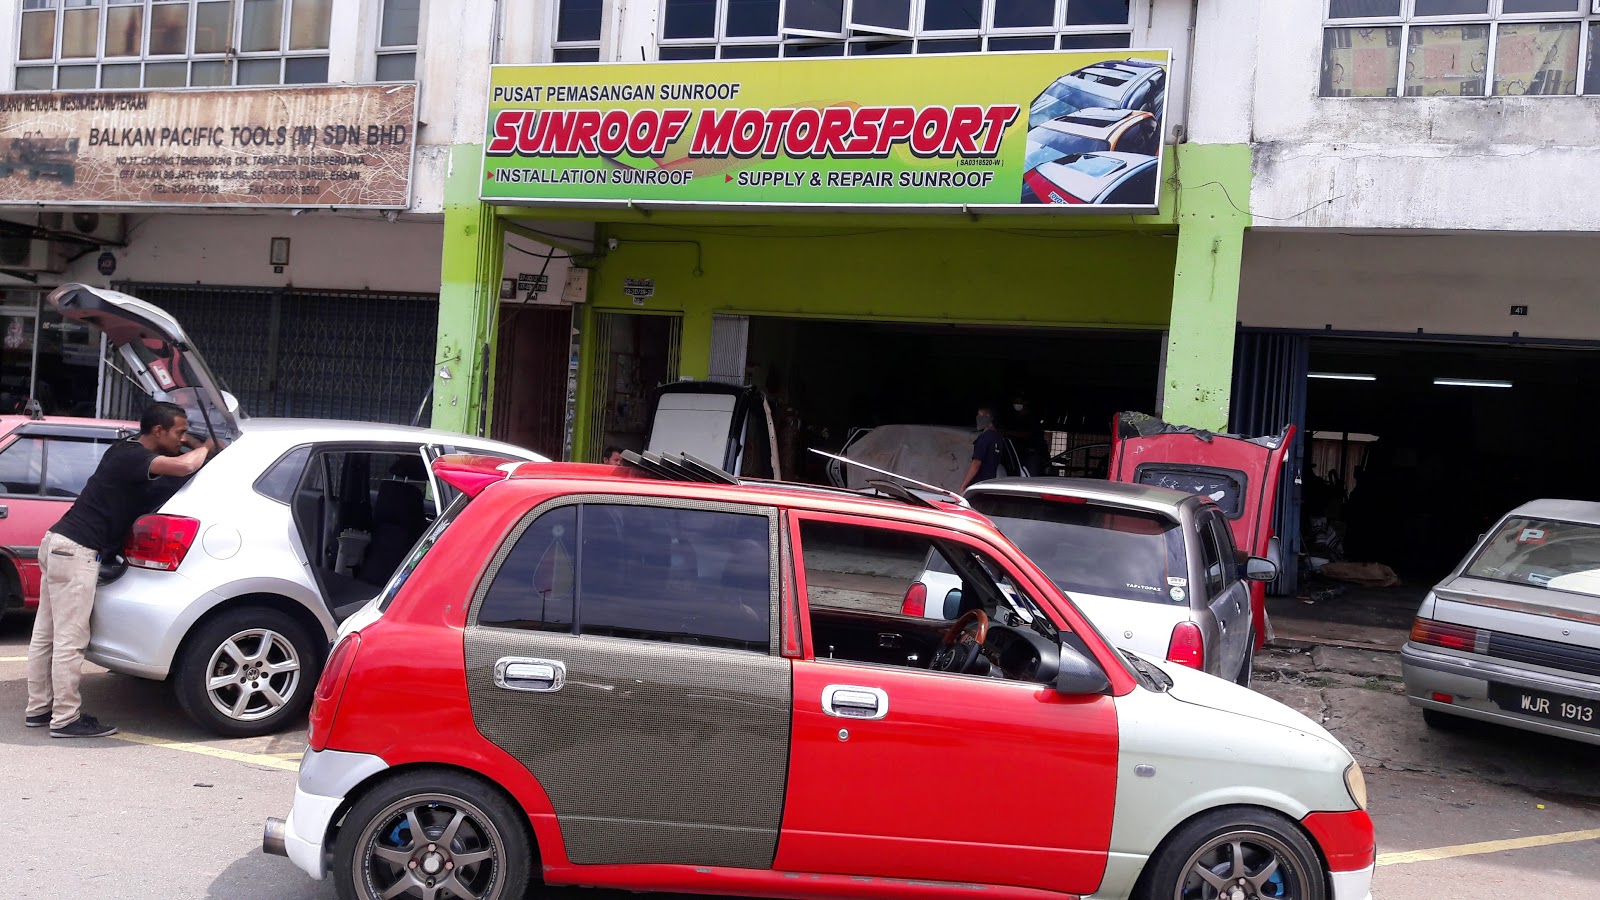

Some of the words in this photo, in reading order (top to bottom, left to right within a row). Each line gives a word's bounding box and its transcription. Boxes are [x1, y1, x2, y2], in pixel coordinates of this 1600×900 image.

[494, 86, 542, 102] PUSAT
[546, 84, 655, 101] PEMASANGAN
[660, 83, 740, 100] SUNROOF
[88, 127, 156, 147] BALKAN
[160, 126, 224, 147] PACIFIC
[230, 125, 287, 146] TOOLS
[292, 125, 317, 151] (M)
[323, 124, 360, 146] SDN
[366, 124, 407, 146] BHD
[486, 109, 692, 157] SUNROOF
[688, 104, 1019, 159] MOTORSPORT
[252, 156, 280, 166] TAMAN
[283, 156, 321, 166] SENTOSA
[251, 170, 297, 180] SELANGOR
[299, 170, 328, 180] DARUL
[330, 170, 360, 181] EHSAN
[495, 168, 607, 184] INSTALLATION
[611, 170, 693, 186] SUNROOF
[737, 171, 806, 188] SUPPLY
[809, 172, 822, 187] &
[826, 171, 893, 188] REPAIR
[898, 170, 994, 188] SUNROOF
[1519, 528, 1545, 542] P
[1521, 694, 1550, 714] WJR
[1560, 702, 1593, 722] 1913
